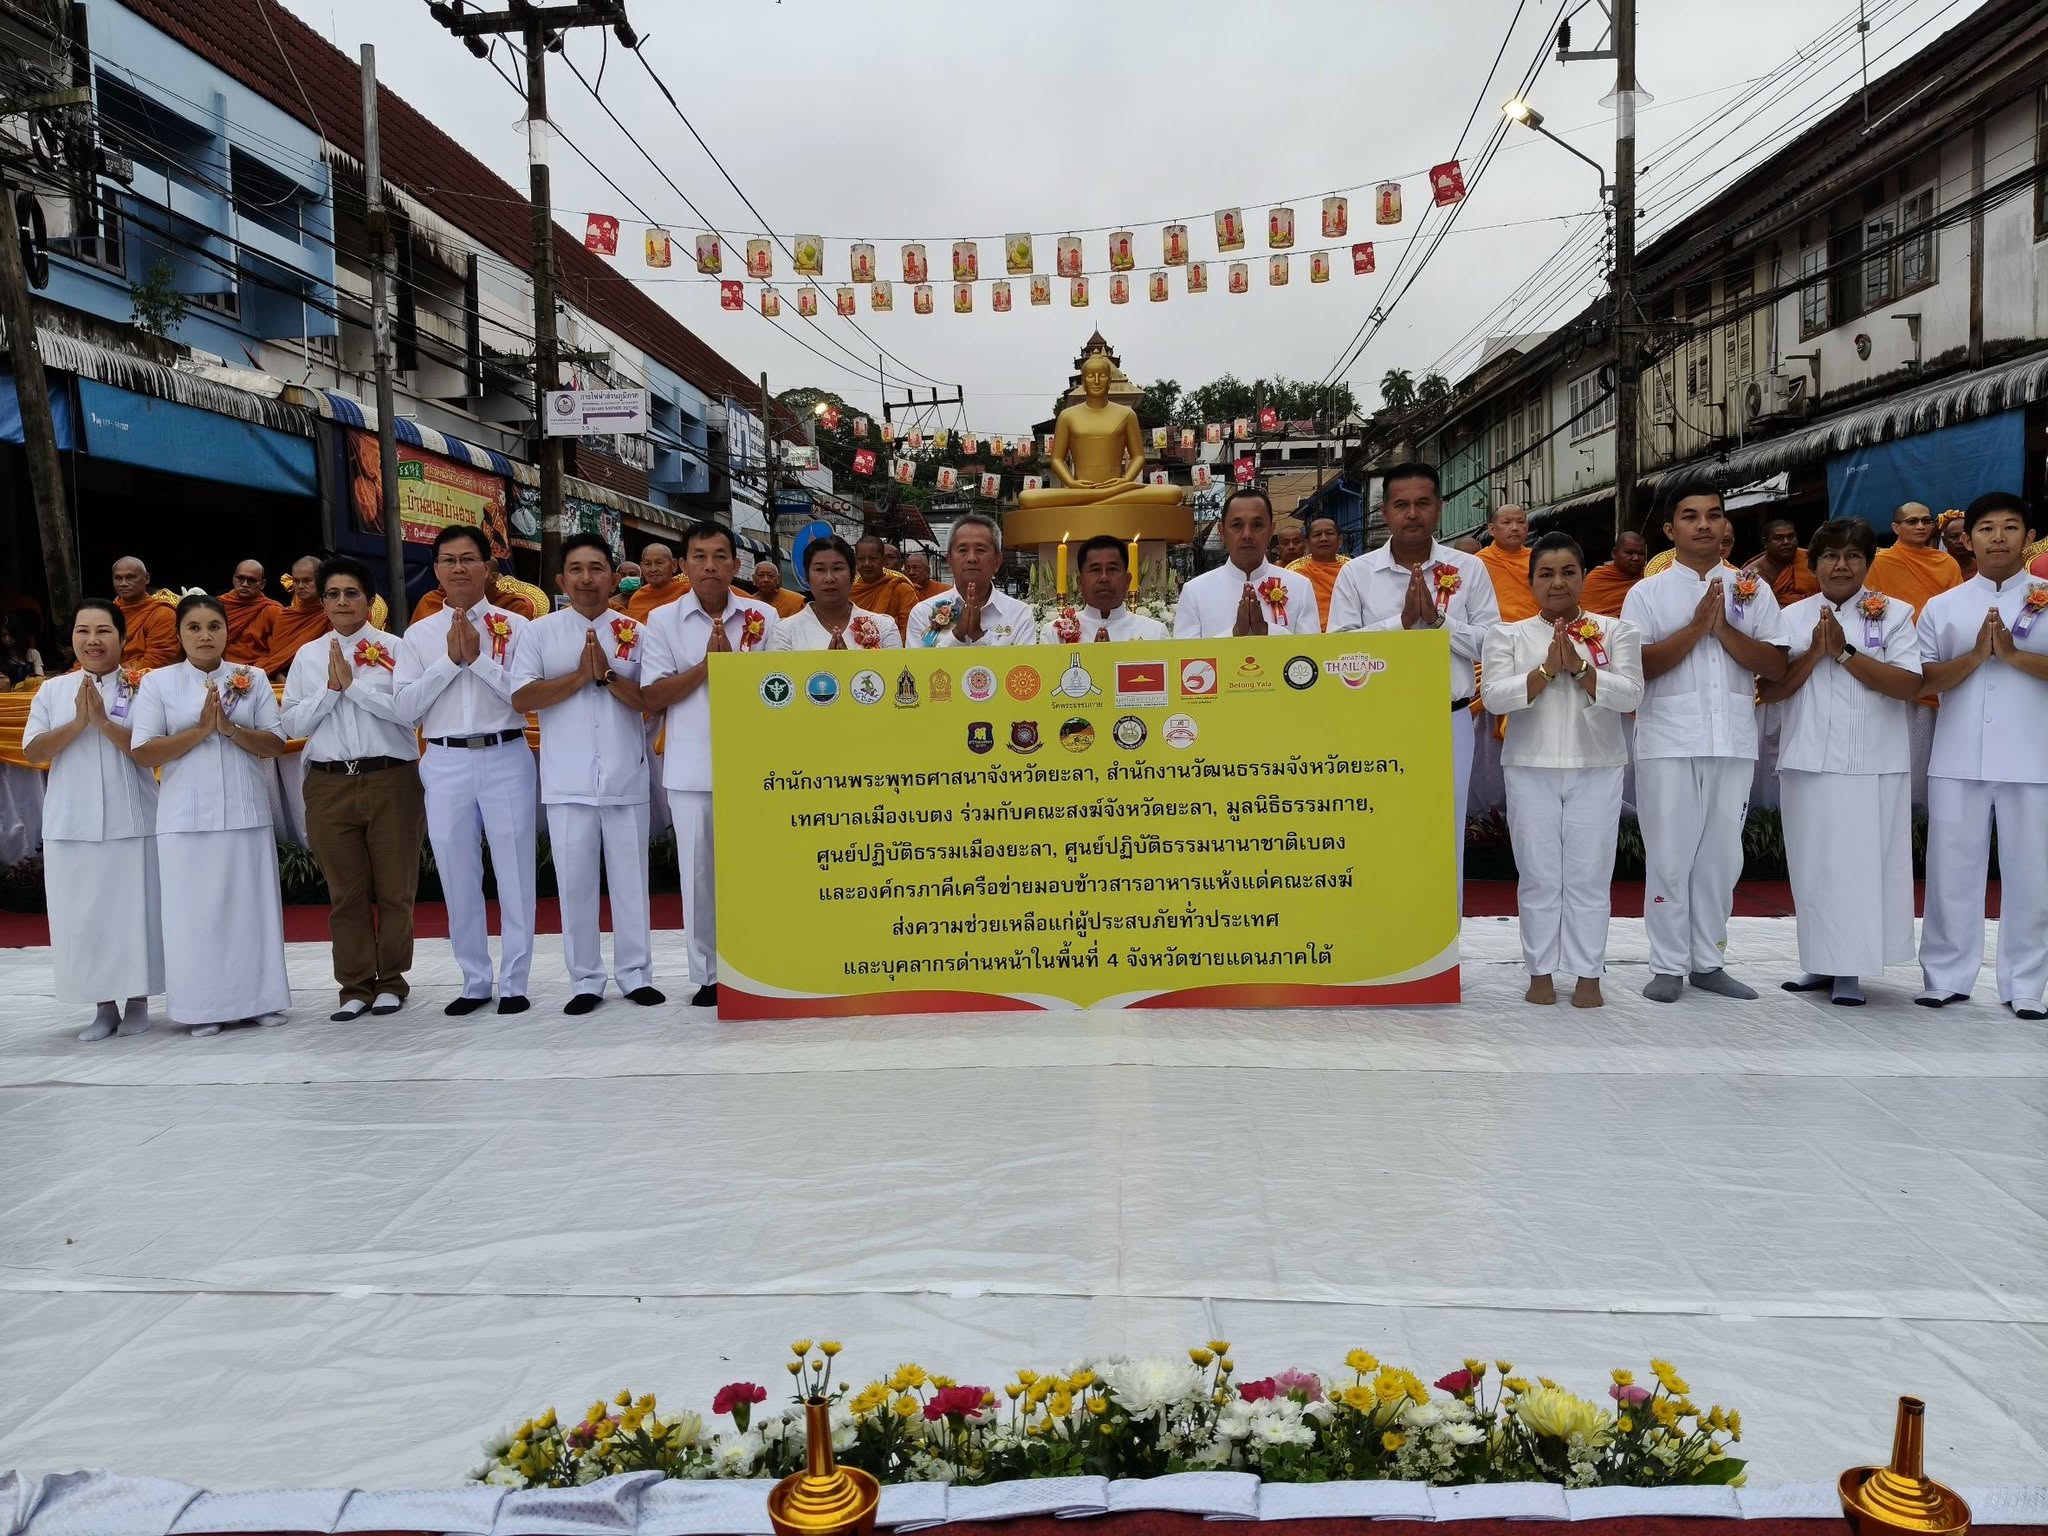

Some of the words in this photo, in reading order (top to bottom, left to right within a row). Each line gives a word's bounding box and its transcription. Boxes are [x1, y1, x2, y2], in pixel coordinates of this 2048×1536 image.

[1325, 661, 1385, 672] THAILAND
[1229, 682, 1255, 690] Betong
[1256, 680, 1272, 688] Yala
[763, 762, 1099, 795] สำนักงานพระพุทธศาสนาจังหวัดยะลา,
[1107, 753, 1404, 781] สำนักงานวัฒนธรรมจังหวัดยะลา,
[791, 803, 953, 827] เทศบาลเมืองเบตง
[960, 796, 1217, 822] ร่วมกับคณะสงฆ์จังหวัดยะลา,
[1226, 794, 1374, 822] มูลนิธิธรรมกาย,
[817, 838, 1057, 871] ศูนย์ปฏิบัติธรรมเมืองยะลา,
[1065, 831, 1345, 864] ศูนย์ปฏิบัติธรรมนานาชาติเบตง
[819, 867, 1354, 900] และองค์กรภาคีเครือข่ายมอบข้าวสารอาหารแห้งแด่คณะสงฆ์
[892, 901, 1279, 937] ส่งความช่วยเหลือแก่ผู้ประสบภัยทั่วประเทศ
[844, 939, 1099, 982] และบุคลากรด่านหน้าในพื้นที่
[1106, 953, 1120, 968] 4
[1126, 941, 1334, 967] จังหวัดชายแดนภาคใต้
